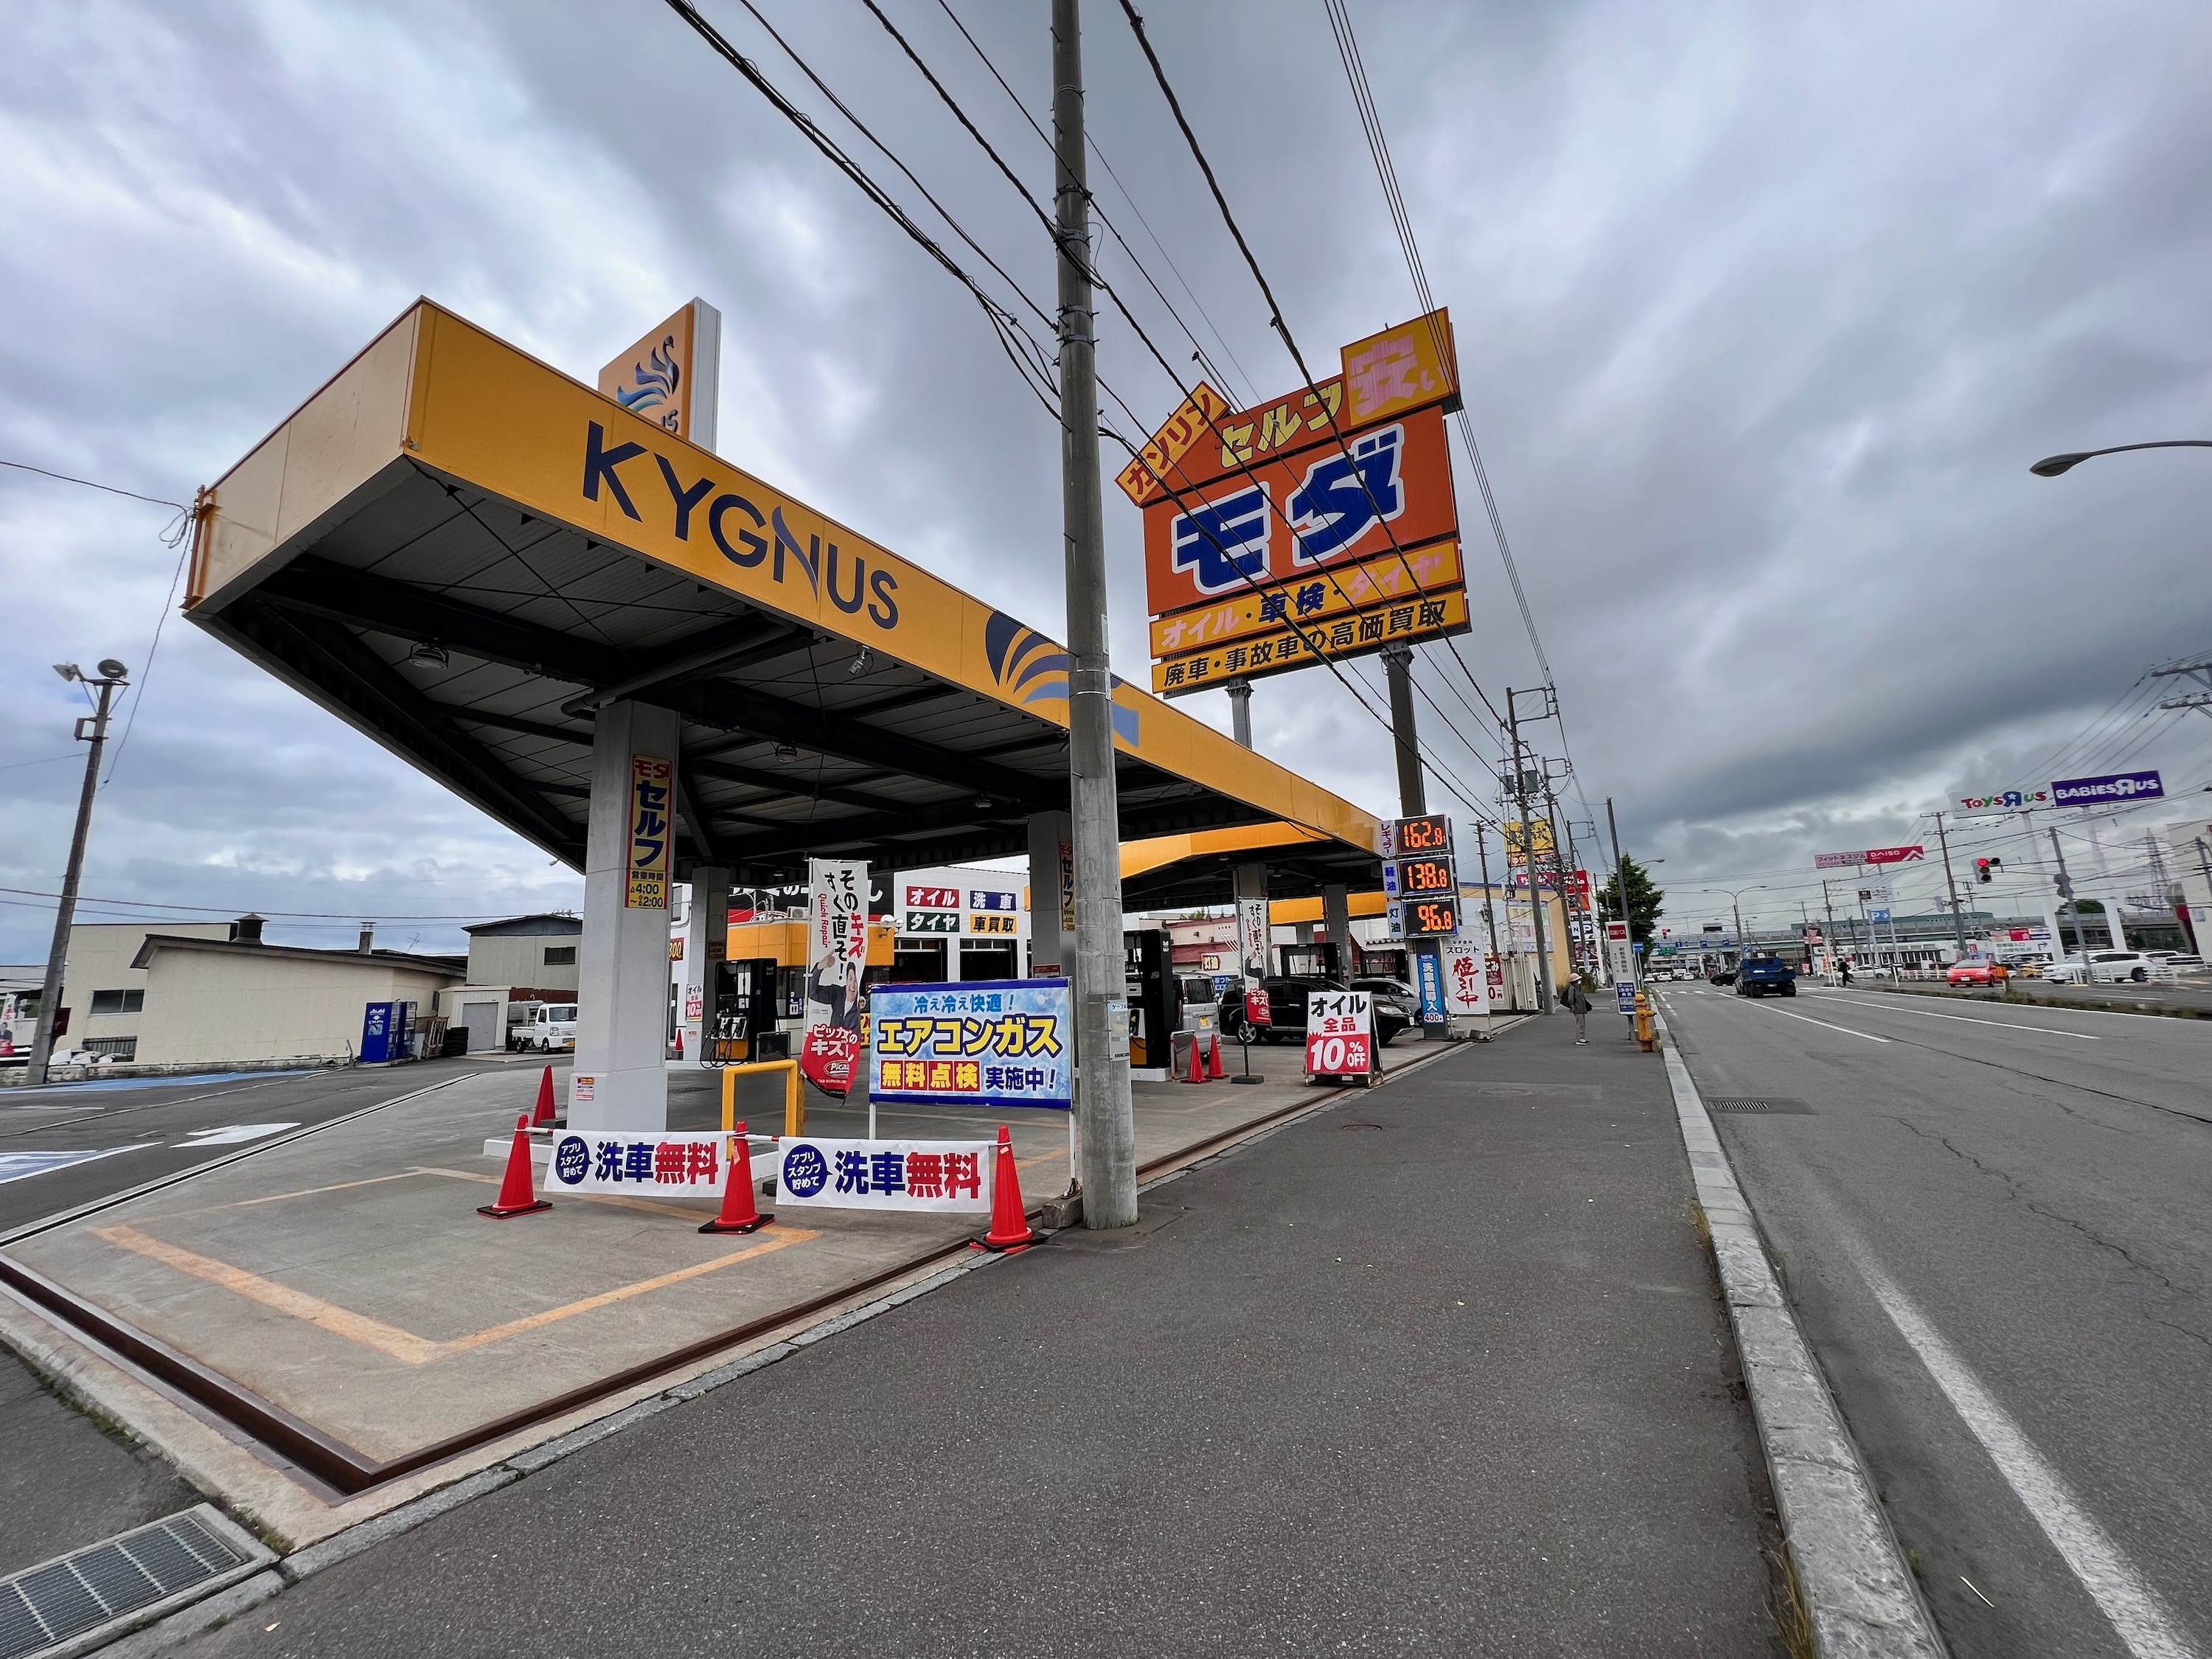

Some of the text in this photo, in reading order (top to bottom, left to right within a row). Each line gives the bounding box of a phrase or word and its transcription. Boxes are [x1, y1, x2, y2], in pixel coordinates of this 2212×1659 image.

[1349, 335, 1449, 417] 安い
[1220, 380, 1342, 468] セルフ
[1127, 393, 1211, 495] ガソリン
[1171, 423, 1404, 595] モダ
[583, 420, 899, 630] KYGNUS
[1164, 599, 1446, 686] 廃車・事故車の高価買取
[635, 759, 669, 779] モダ
[634, 780, 667, 867] セルフ
[1381, 824, 1392, 854] レギュラー
[1385, 866, 1397, 891] 軽油
[910, 888, 956, 907] オイル
[973, 891, 1013, 910] 洗車
[910, 913, 956, 931] タイヤ
[973, 916, 1015, 933] 車買取
[1871, 912, 1879, 920] P
[1446, 946, 1480, 954] スロット
[1311, 995, 1367, 1018] オイル
[877, 1013, 1062, 1057] エアコンガス
[1324, 1018, 1356, 1032] 全品
[1347, 1053, 1366, 1067] OFF
[882, 1061, 979, 1089] 無料点検
[561, 1142, 581, 1155] アプリ
[791, 1151, 815, 1164] アプリ
[560, 1152, 585, 1167] スタンプ
[594, 1141, 719, 1185] 洗車無料
[563, 1165, 583, 1178] 貯めて
[787, 1162, 821, 1178] スタンプ
[835, 1150, 981, 1200] 洗車無料
[792, 1176, 820, 1191] 貯めて
